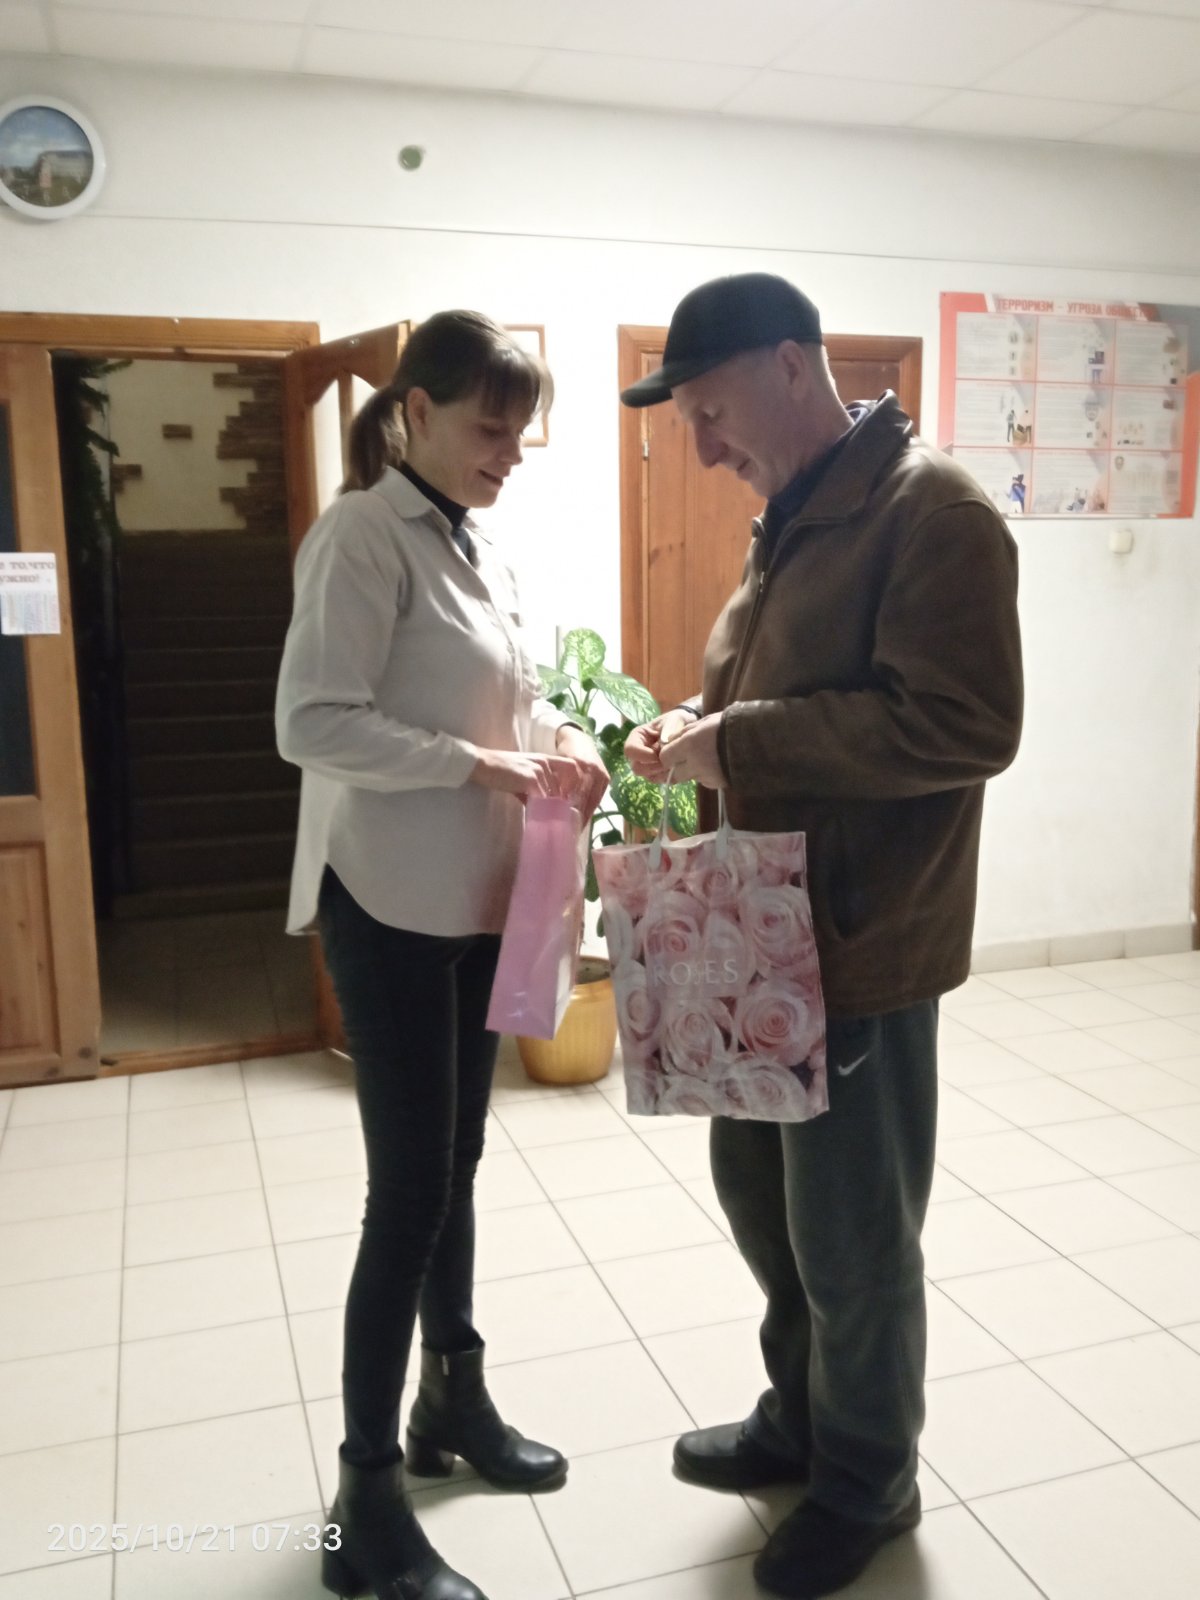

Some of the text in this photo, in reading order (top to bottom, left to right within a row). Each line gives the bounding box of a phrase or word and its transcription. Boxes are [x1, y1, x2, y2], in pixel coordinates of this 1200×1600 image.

[996, 298, 1054, 313] ТЕРРОРИЗМ
[1067, 302, 1102, 315] УГРОЗА
[653, 958, 738, 987] ROSES
